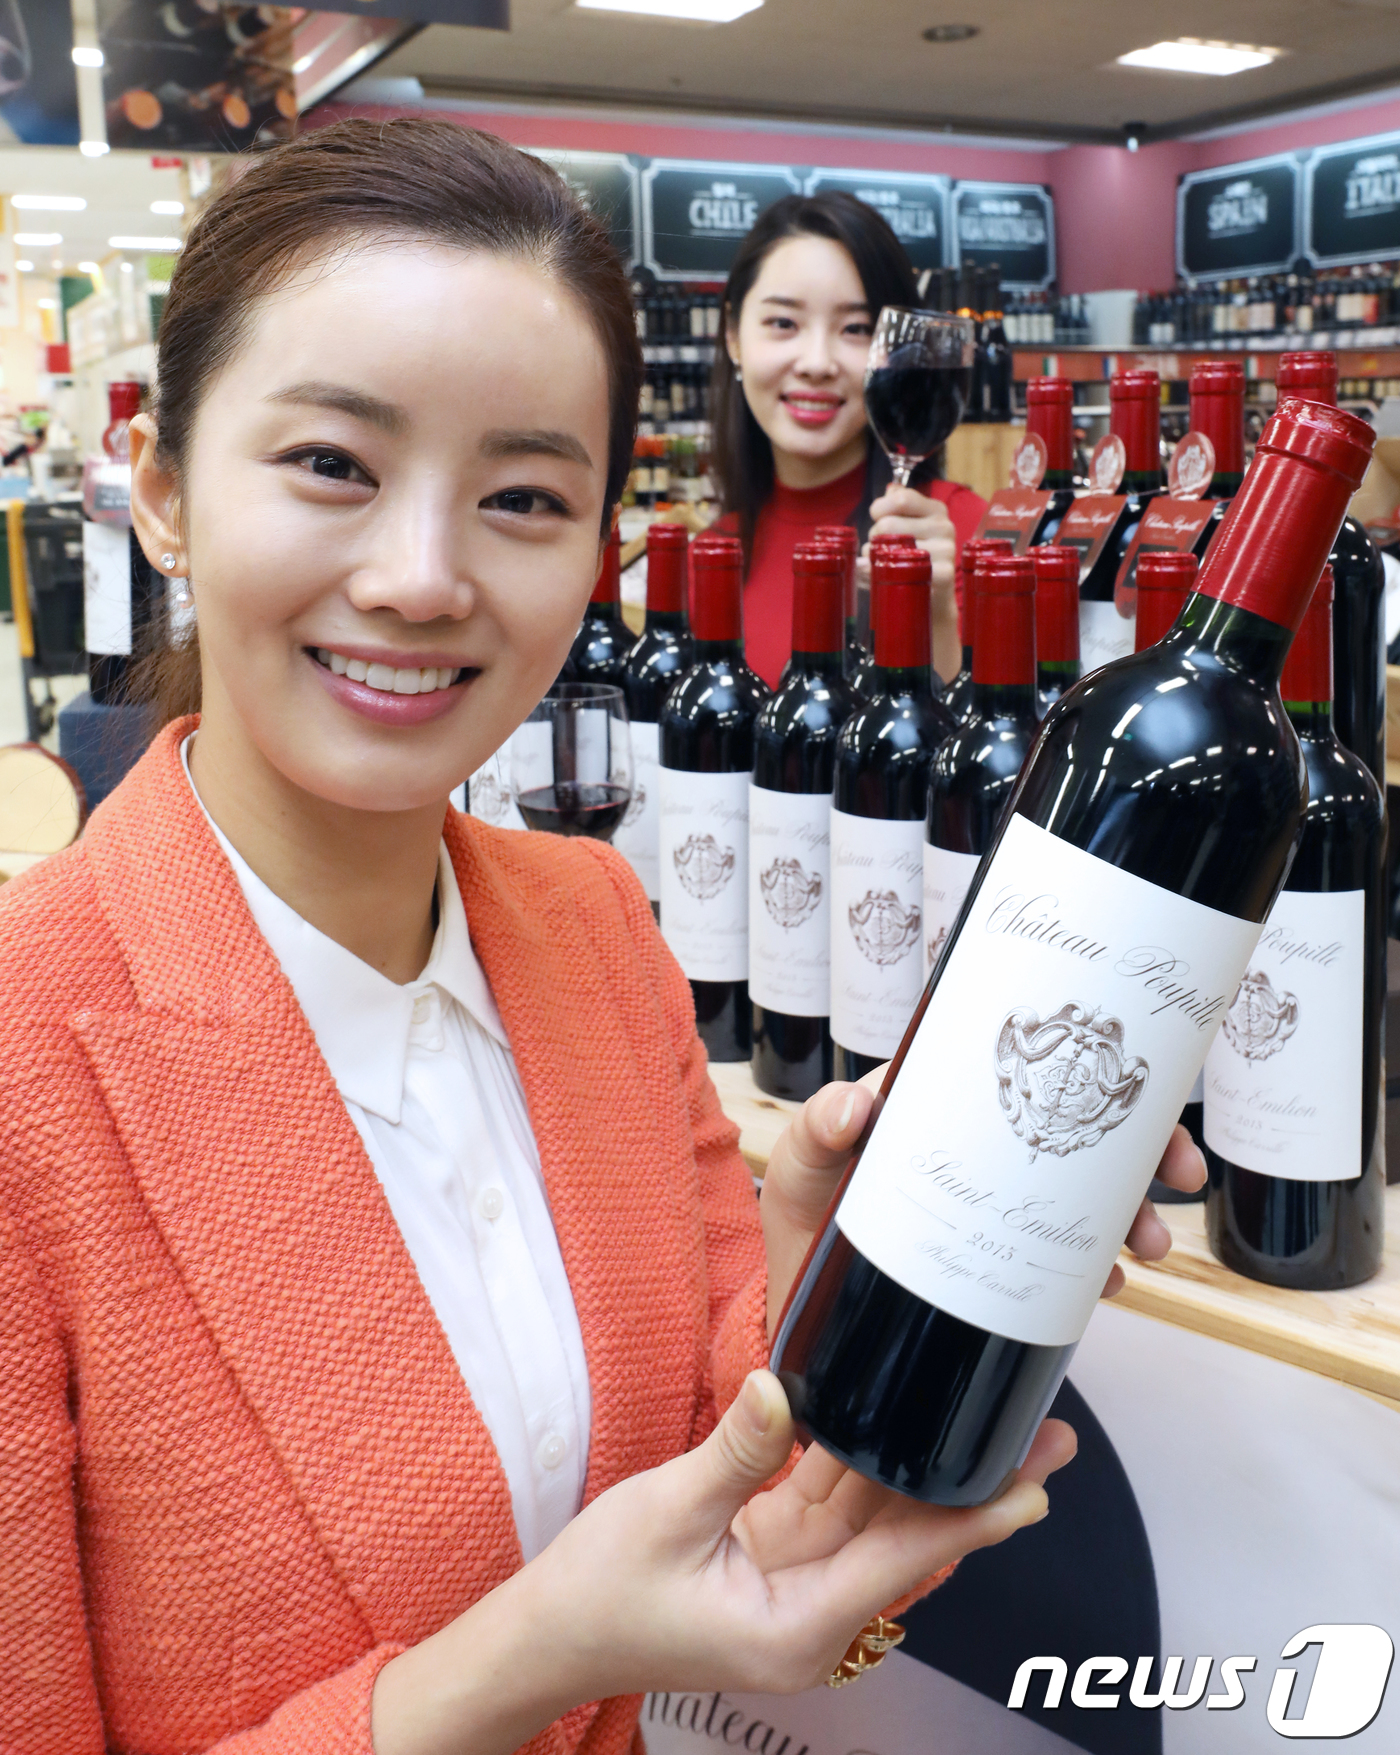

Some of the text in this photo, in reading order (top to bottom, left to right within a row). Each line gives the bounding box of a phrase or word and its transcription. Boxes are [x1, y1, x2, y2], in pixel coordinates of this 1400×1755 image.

[689, 198, 758, 231] CHILE
[1207, 193, 1268, 231] SPAIN
[986, 884, 1226, 1031] Château Poupille
[914, 1240, 977, 1280] Philippe
